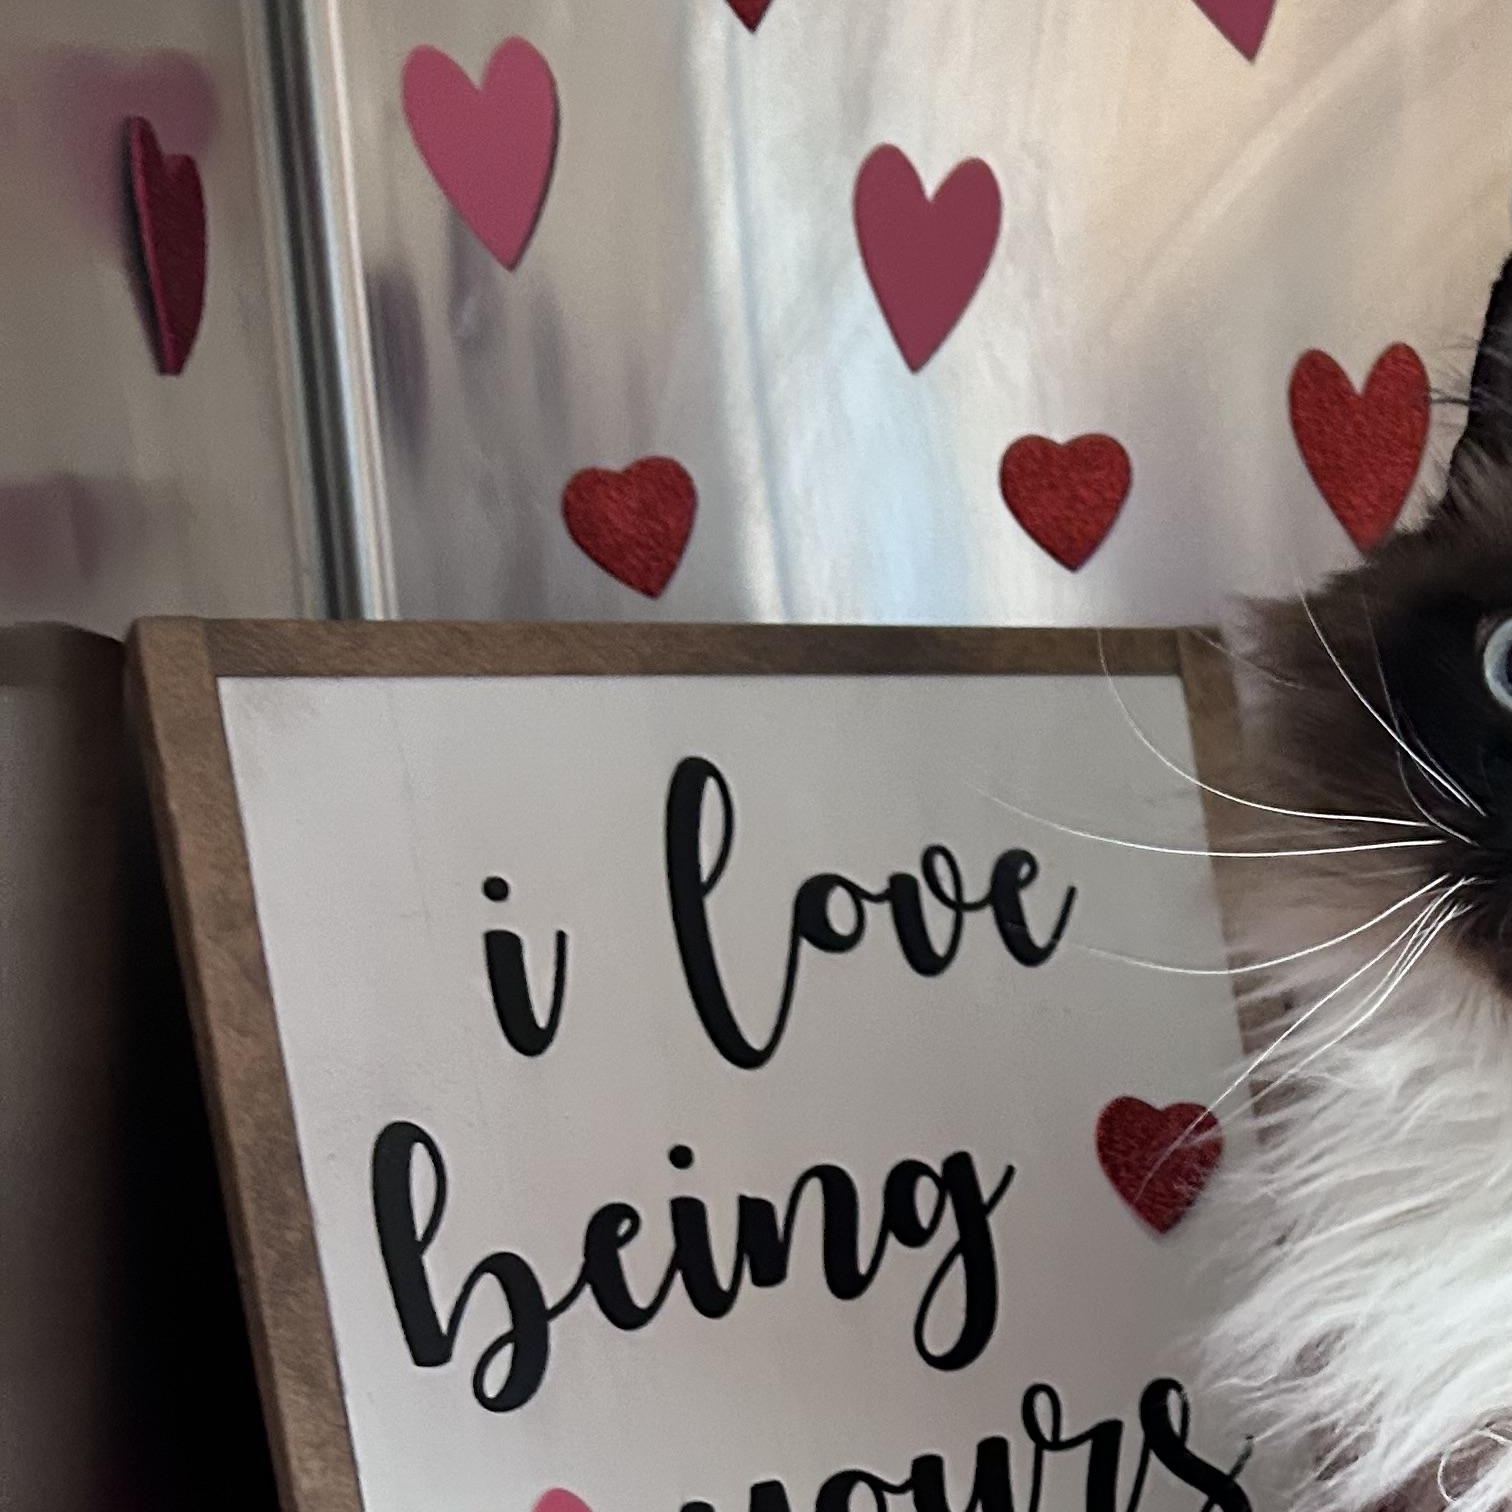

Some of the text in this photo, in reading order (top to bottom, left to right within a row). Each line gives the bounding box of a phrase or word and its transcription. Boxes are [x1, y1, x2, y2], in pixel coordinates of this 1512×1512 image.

[482, 755, 1077, 1071] i love
[370, 1120, 1016, 1414] being
